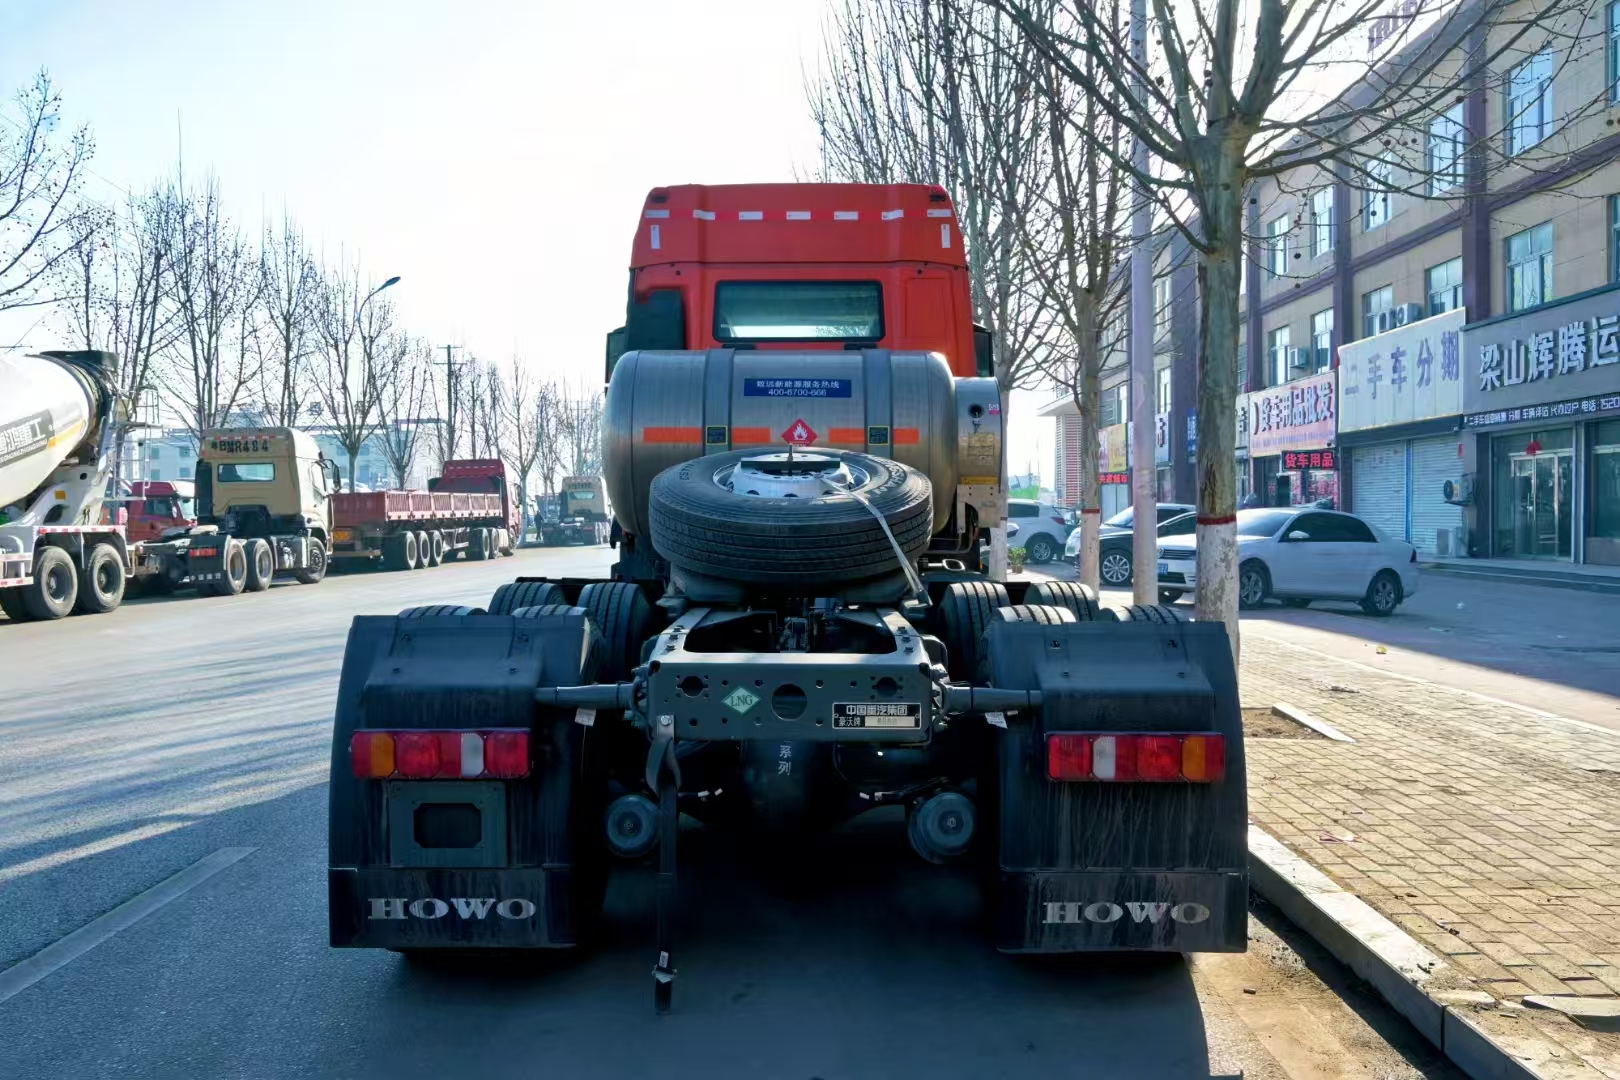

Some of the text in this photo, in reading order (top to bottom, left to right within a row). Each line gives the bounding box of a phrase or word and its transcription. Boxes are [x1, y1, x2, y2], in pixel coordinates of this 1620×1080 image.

[1479, 316, 1620, 391] 梁山辉腾运
[1344, 331, 1459, 400] 二手车分期
[756, 380, 840, 389] 致远新能源服务热线
[768, 388, 827, 396] 400-6700-666
[1285, 452, 1333, 468] 货车用品
[730, 693, 753, 707] LNG
[846, 705, 907, 716] 中国重汽集团
[838, 716, 861, 727] 豪沃牌
[778, 741, 792, 776] 系列
[367, 898, 536, 920] HOWO
[1042, 901, 1210, 924] HOWO
